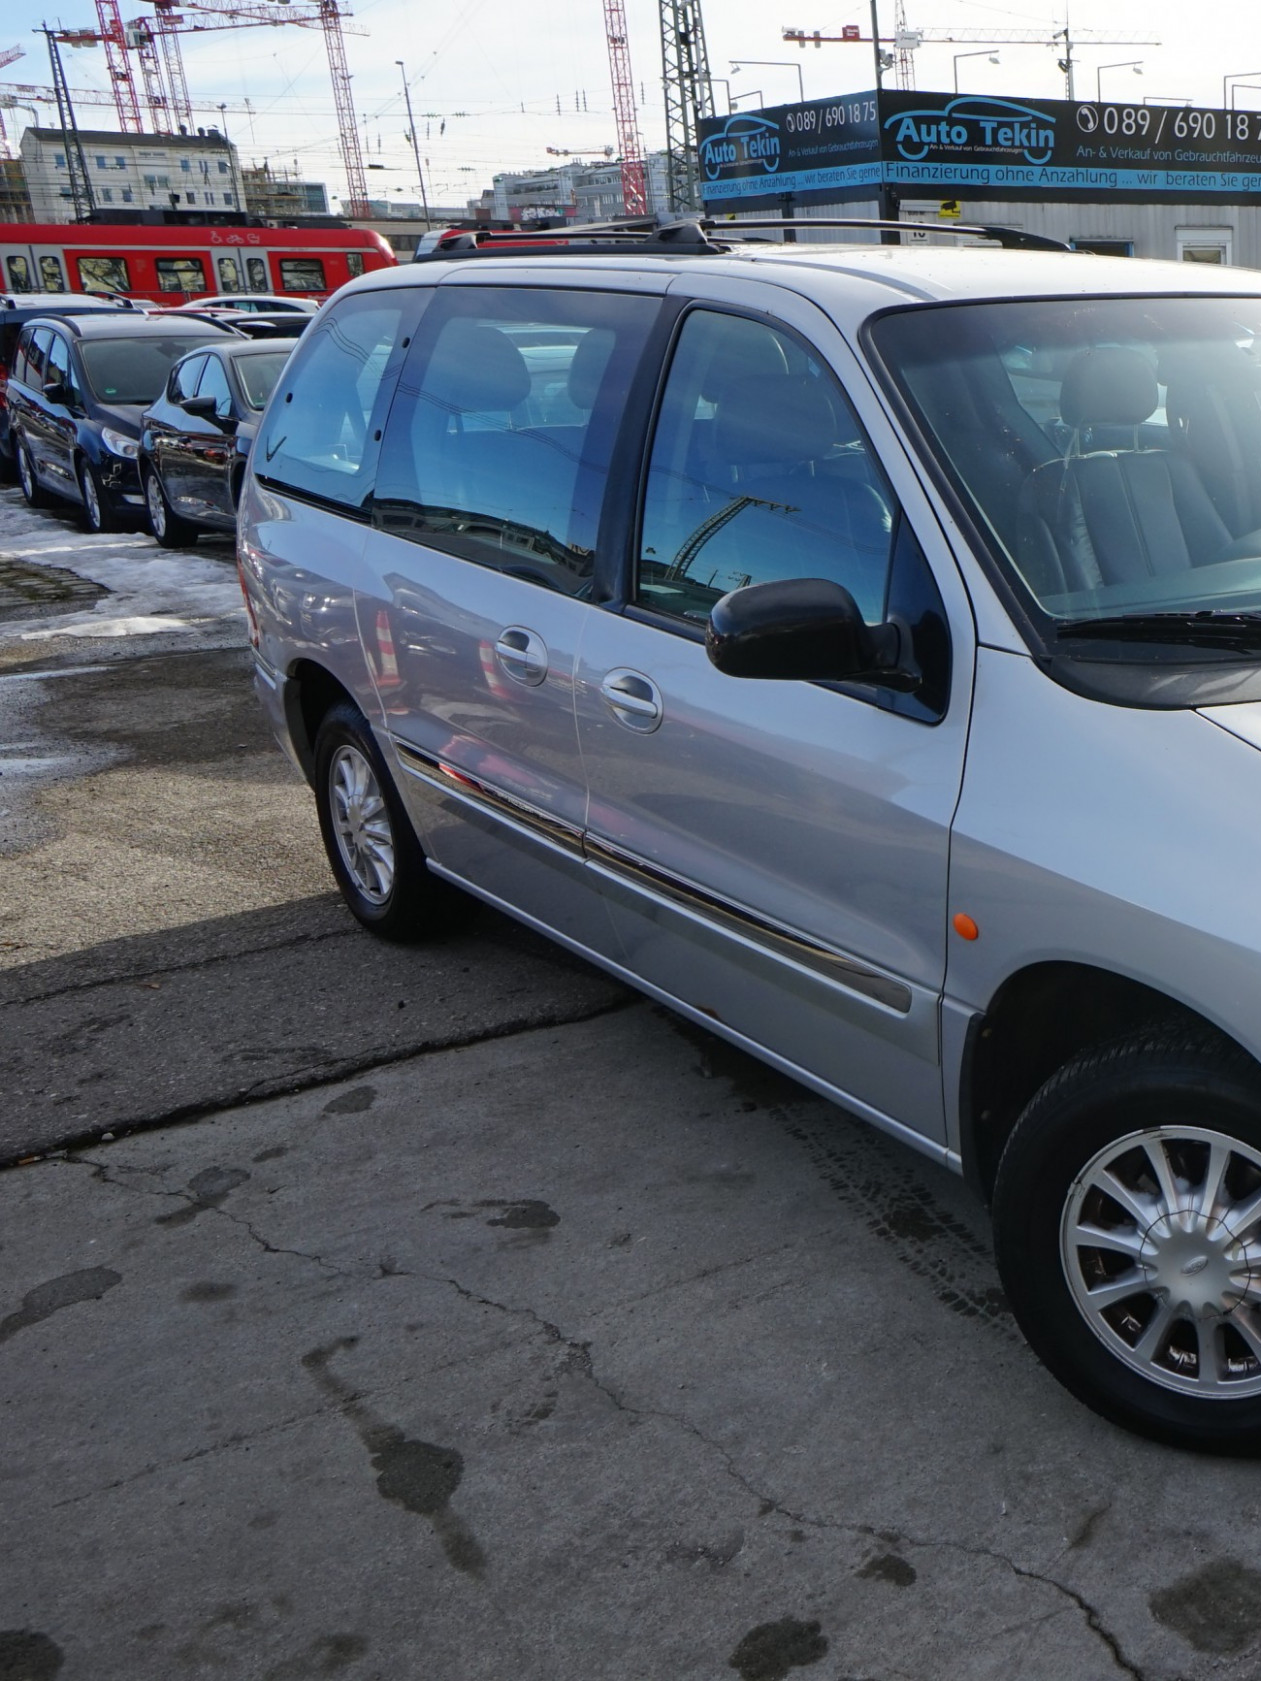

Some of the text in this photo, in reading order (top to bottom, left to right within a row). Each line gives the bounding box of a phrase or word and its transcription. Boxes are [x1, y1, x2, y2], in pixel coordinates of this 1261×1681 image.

[797, 110, 816, 131] 089
[825, 106, 845, 127] 690
[849, 104, 860, 124] 18
[862, 101, 876, 121] 75
[1103, 107, 1150, 135] 089
[1155, 110, 1167, 144] /
[1174, 112, 1216, 139] 690
[1226, 114, 1249, 140] 18
[896, 118, 1054, 148] Auto Tekin
[704, 133, 780, 164] Auto Tekin
[1076, 145, 1096, 157] An-
[1099, 146, 1107, 158] &
[1110, 147, 1150, 160] Verkauf
[1153, 151, 1172, 160] von
[703, 182, 741, 195] Finanzierung
[759, 175, 796, 189] Anzahlung
[805, 174, 816, 184] wir
[818, 169, 845, 182] beraten
[846, 167, 857, 180] Sie
[859, 168, 880, 183] gerne
[886, 162, 990, 184] Finanzierung
[995, 167, 1034, 181] ohne
[1039, 168, 1118, 188] Anzahlung
[1137, 172, 1158, 184] wir
[1166, 172, 1217, 186] beraten
[1220, 173, 1238, 187] Sie
